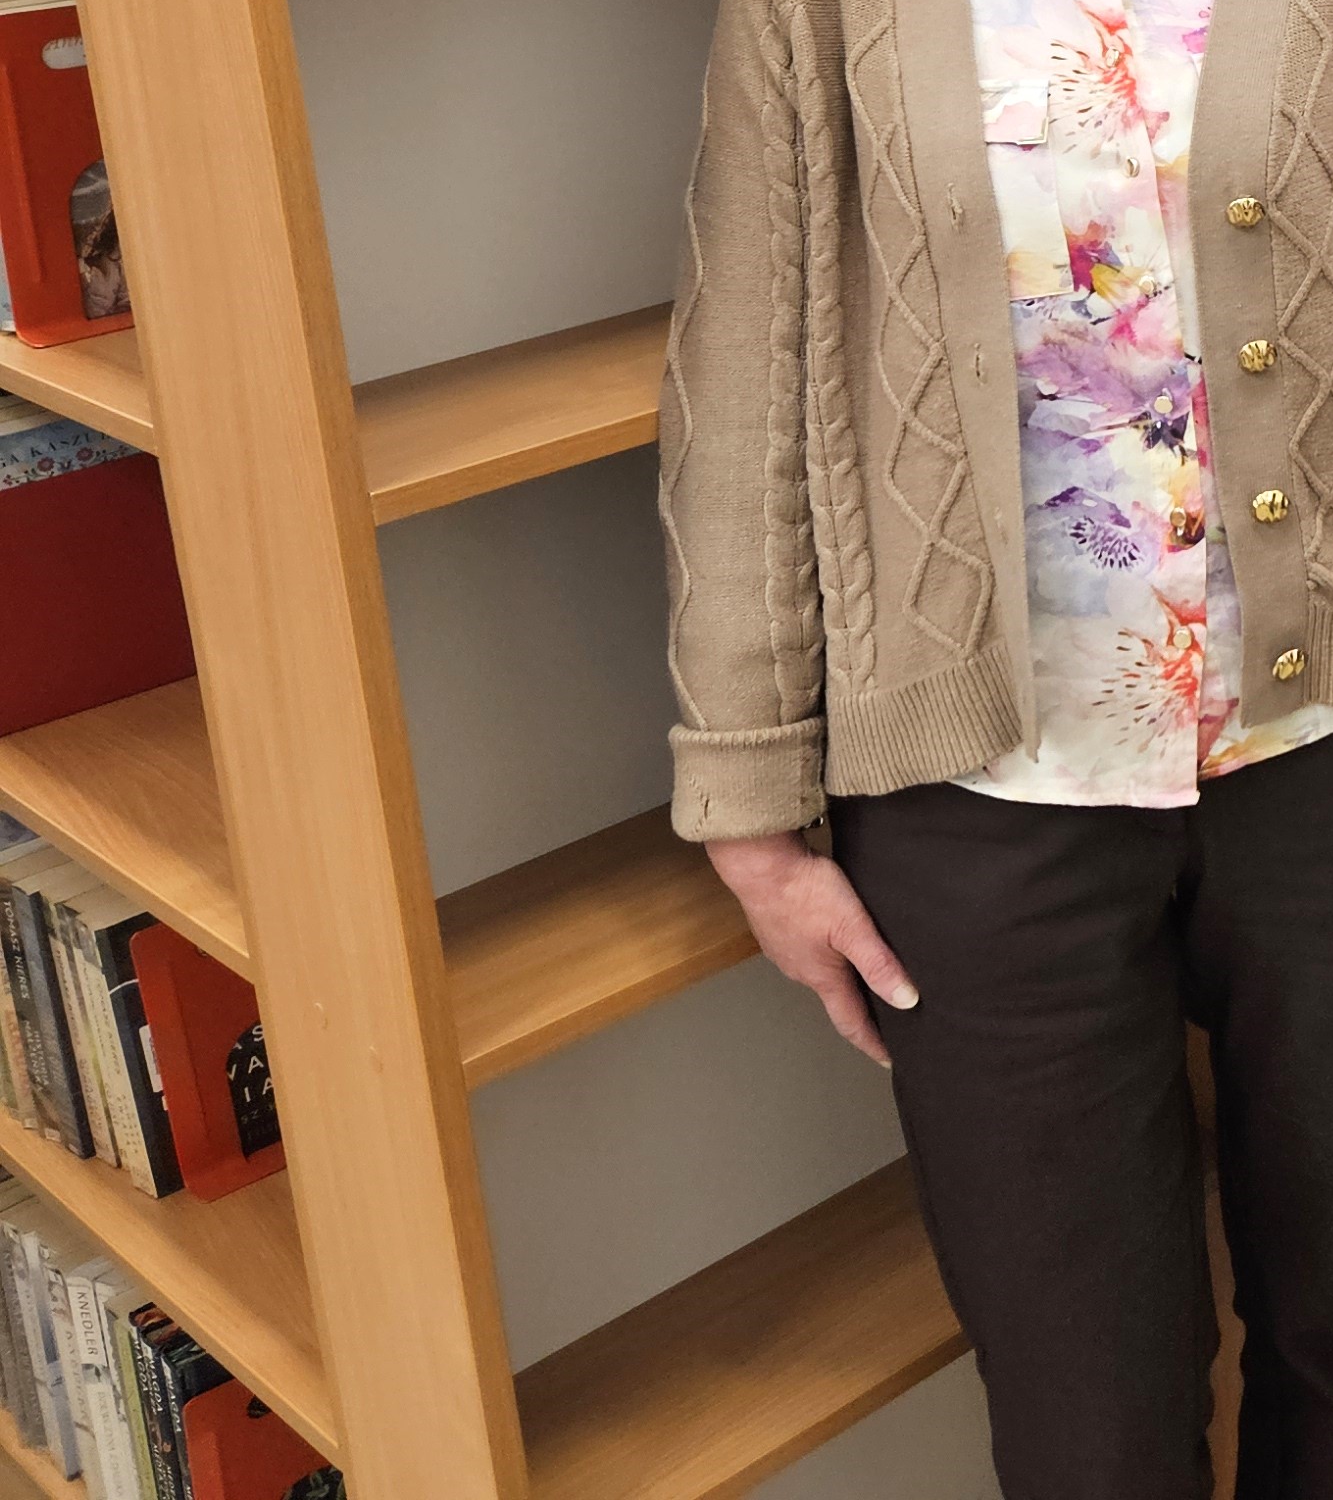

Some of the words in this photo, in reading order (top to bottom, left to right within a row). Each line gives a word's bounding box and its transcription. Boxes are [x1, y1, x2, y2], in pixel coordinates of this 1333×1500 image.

[4, 901, 22, 954] TOMASZ
[14, 954, 30, 1000] KIERES
[77, 1291, 99, 1356] KNEDLER
[133, 1338, 150, 1393] MAGDA
[149, 1360, 164, 1413] MAGDA
